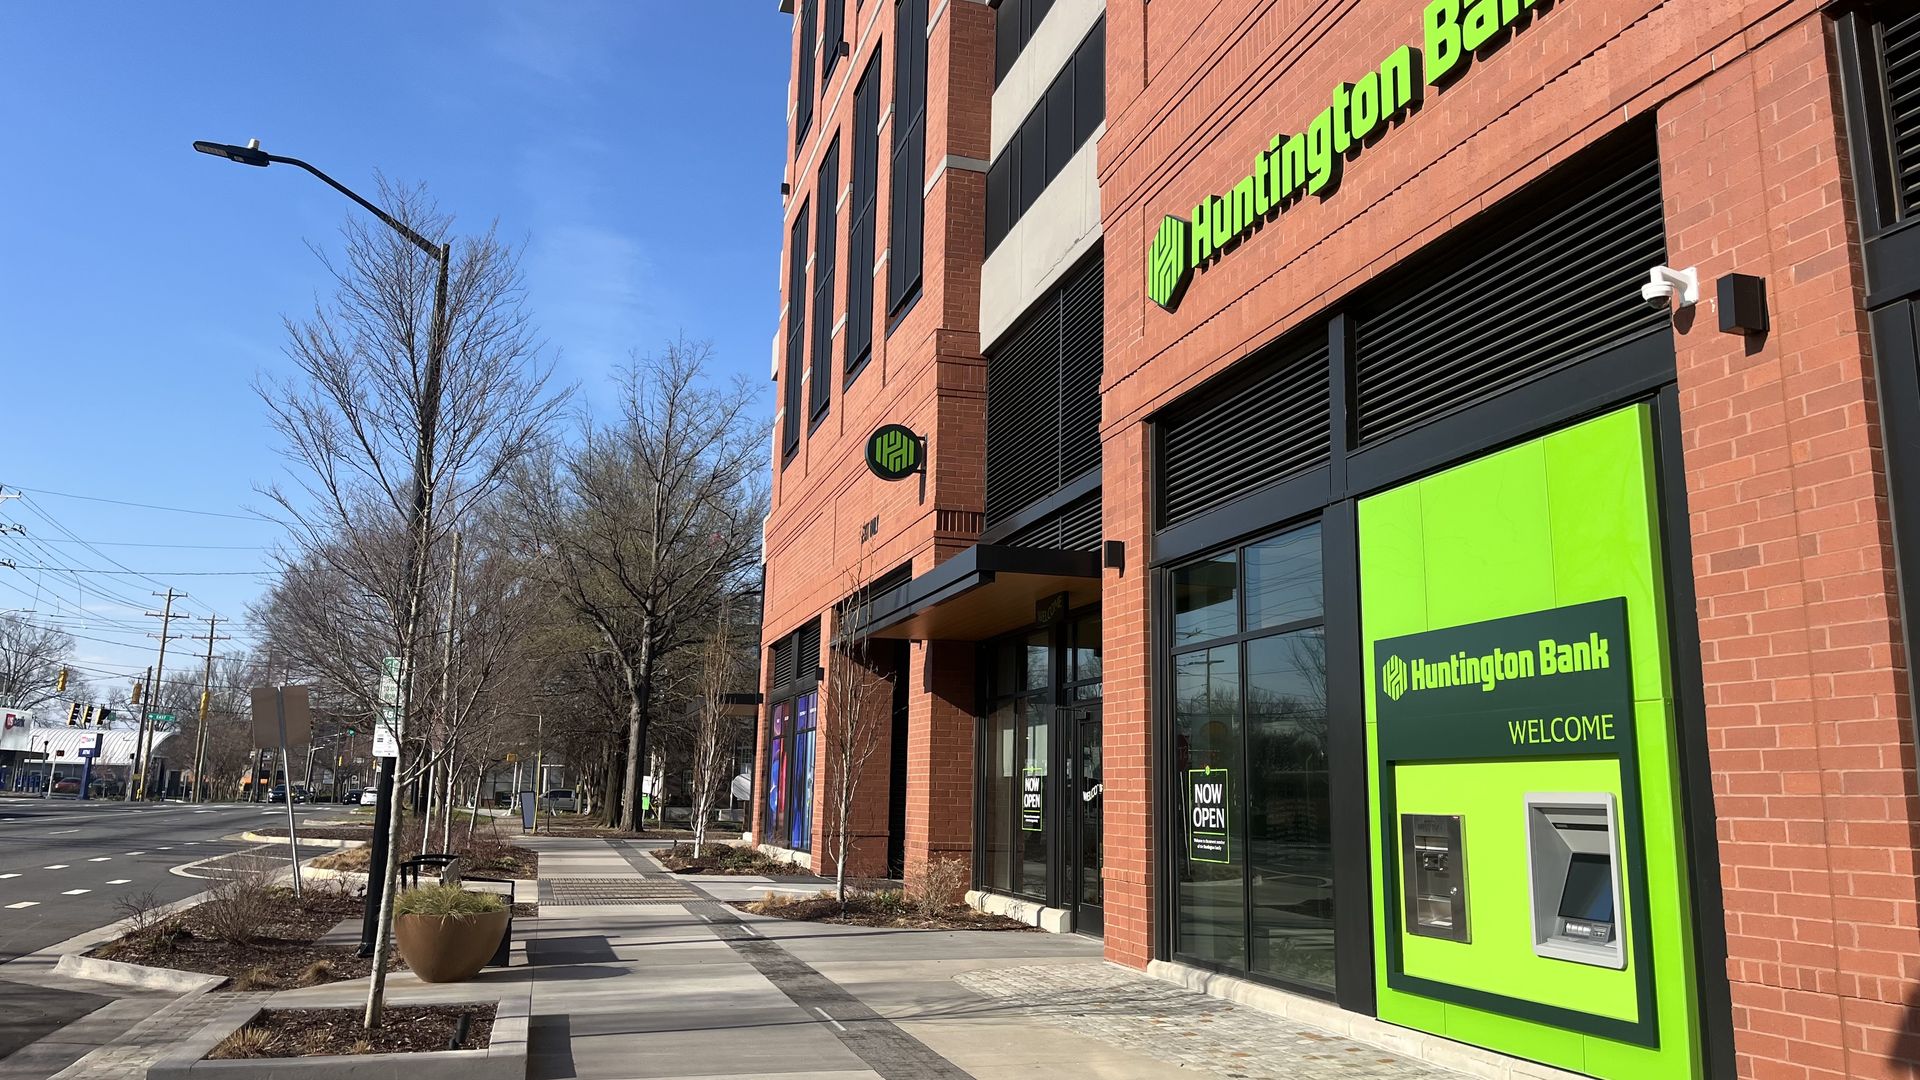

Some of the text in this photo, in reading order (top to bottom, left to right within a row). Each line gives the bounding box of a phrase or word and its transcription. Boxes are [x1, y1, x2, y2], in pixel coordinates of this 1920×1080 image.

[1191, 44, 1412, 268] Huntington
[1411, 632, 1610, 692] Huntington Bank
[1508, 714, 1615, 744] WELCOME
[1025, 777, 1040, 792] NOW
[1194, 783, 1223, 804] NOW
[1024, 793, 1041, 808] OPEN
[1193, 807, 1225, 828] OPEN
